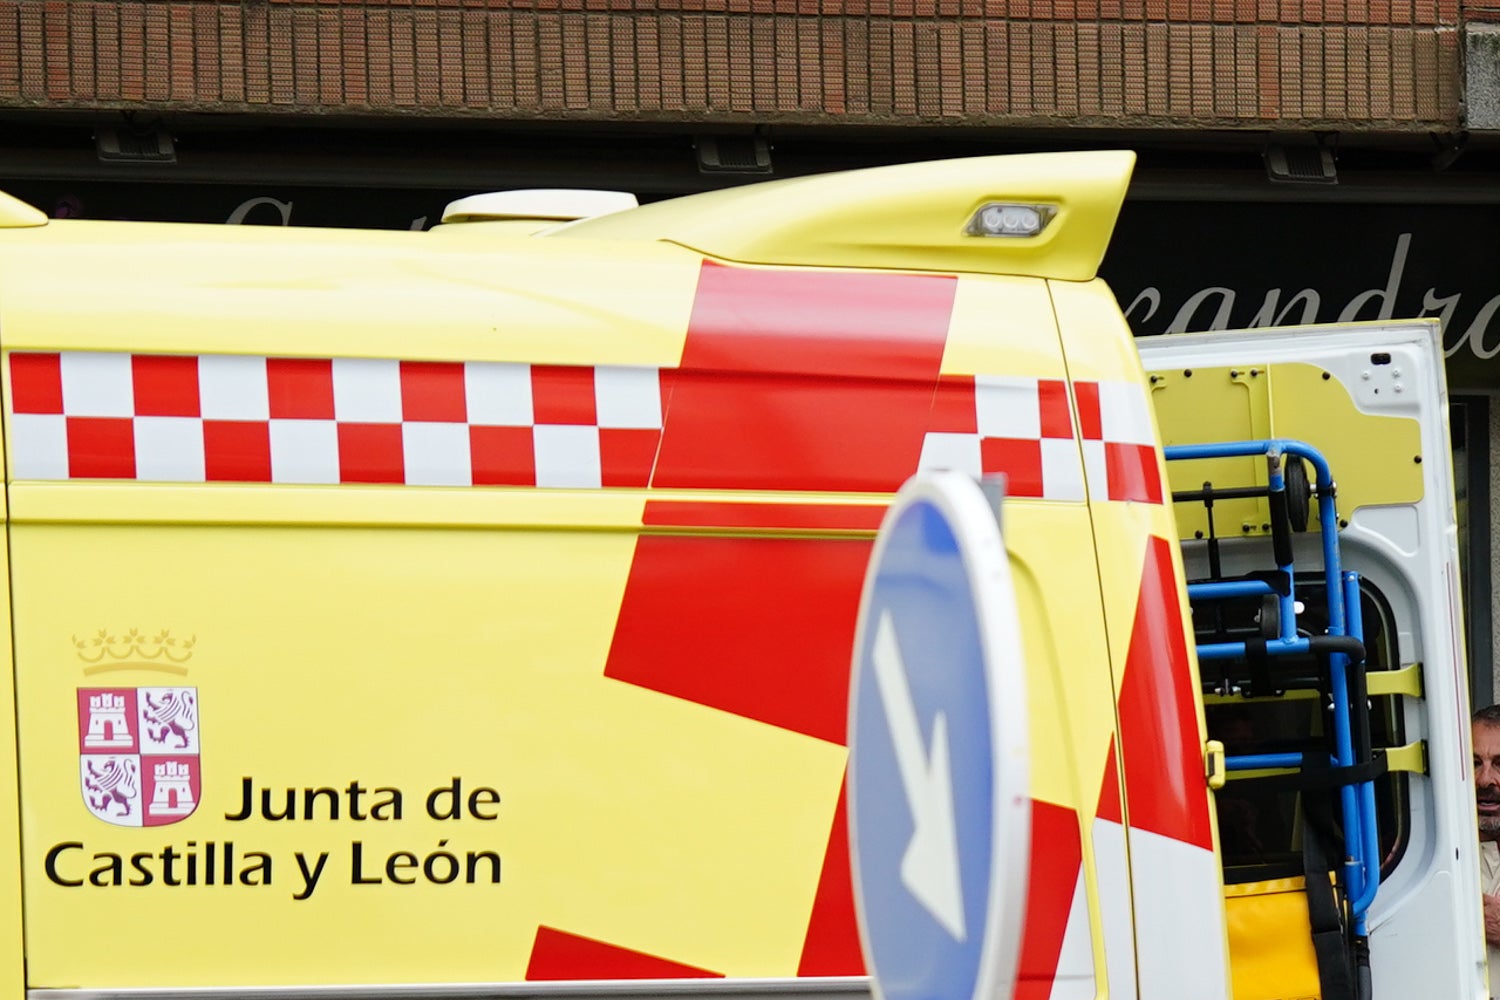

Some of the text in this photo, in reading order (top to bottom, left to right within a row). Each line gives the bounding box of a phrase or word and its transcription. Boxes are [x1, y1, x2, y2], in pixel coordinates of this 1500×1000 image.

[225, 777, 501, 822] Junta de
[44, 839, 501, 901] Castilla y León
